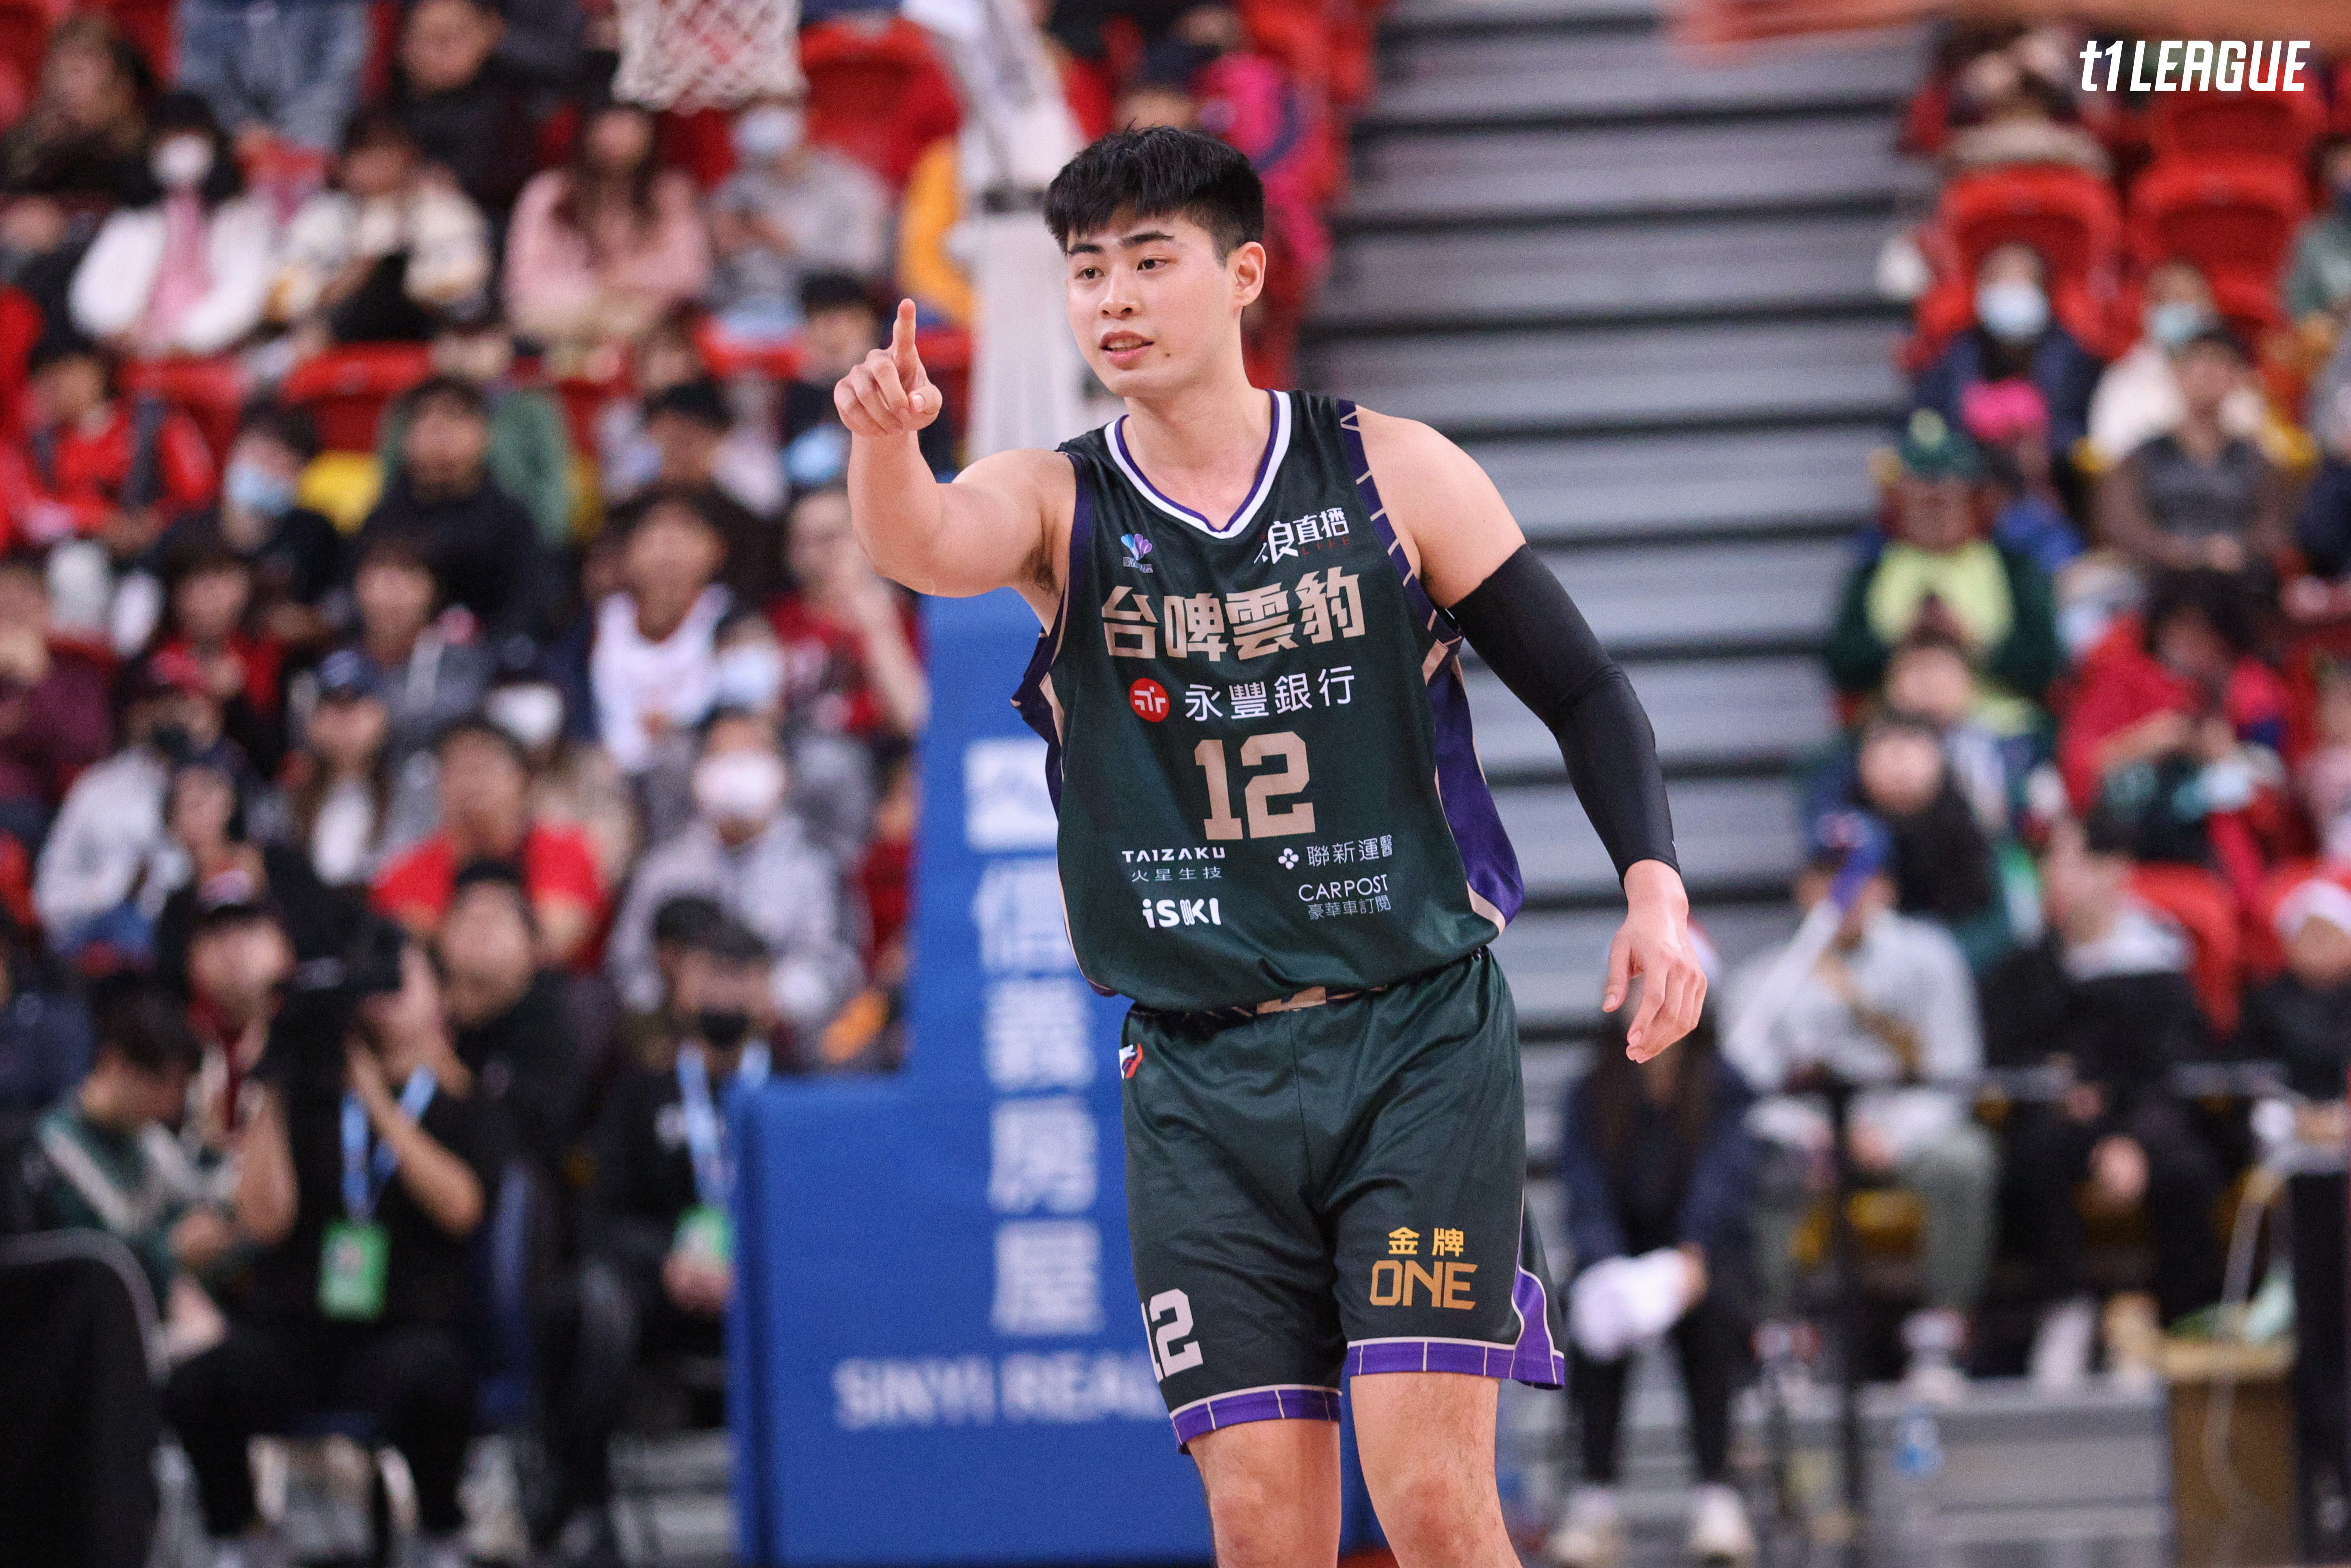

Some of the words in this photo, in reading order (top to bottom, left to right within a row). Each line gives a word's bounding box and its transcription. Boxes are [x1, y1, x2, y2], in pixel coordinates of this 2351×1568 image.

[1101, 566, 1365, 662] 台啤雲豹
[1185, 665, 1355, 722] 永豐銀行
[1194, 731, 1316, 840] 12
[1122, 847, 1225, 863] TAIZAKU
[1131, 866, 1222, 882] 火星生技
[1298, 874, 1388, 902] CARPOST
[1388, 1227, 1465, 1257] 金牌
[1369, 1260, 1478, 1310] ONE
